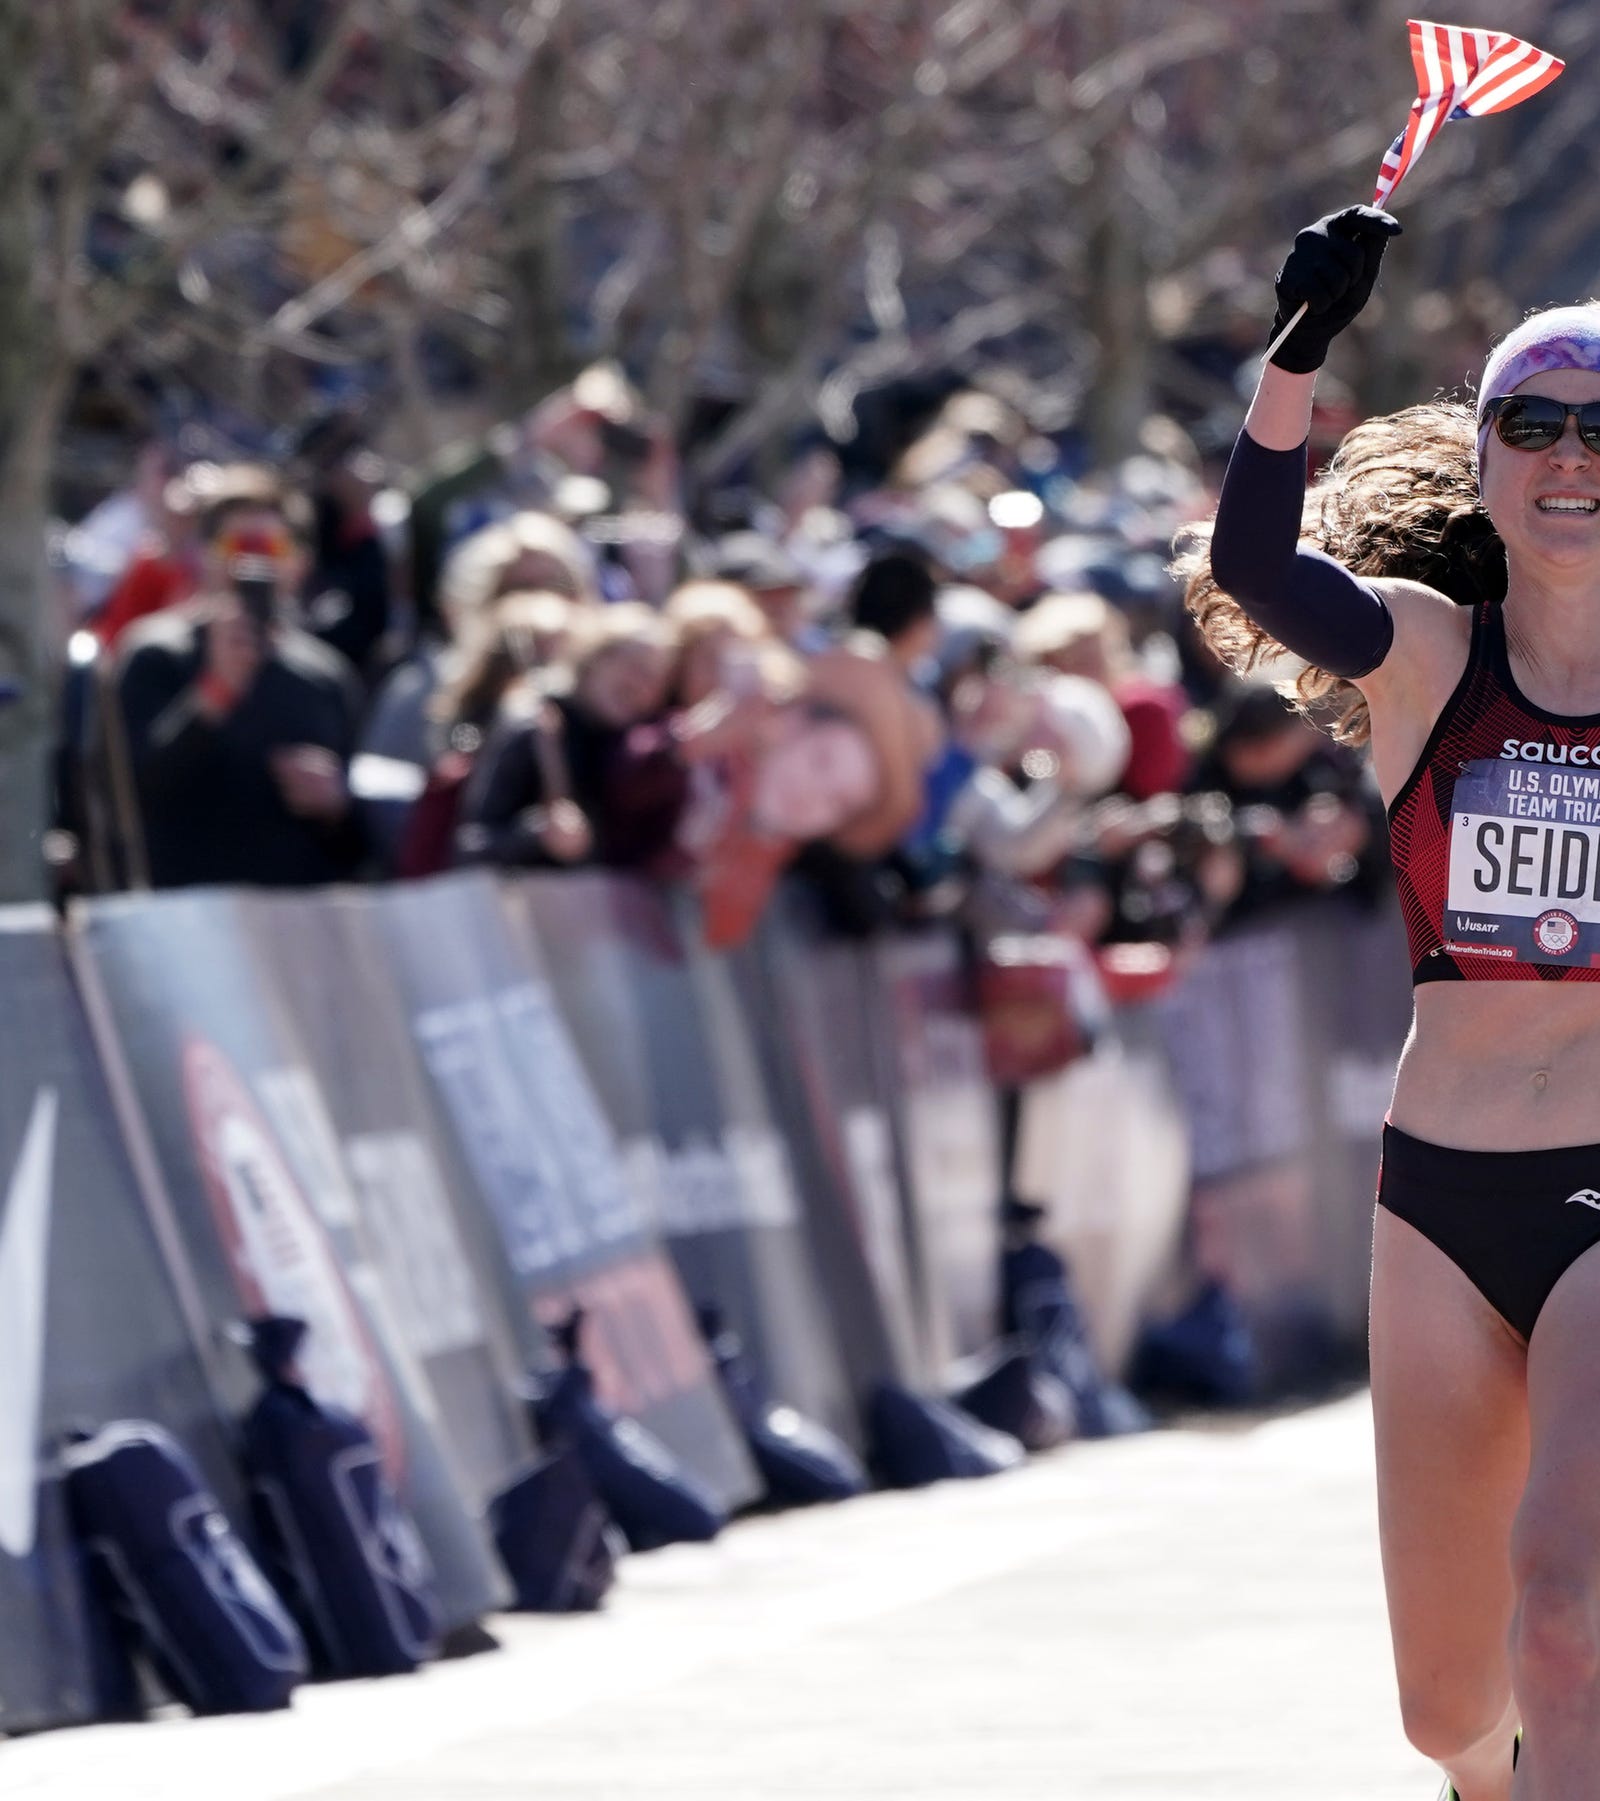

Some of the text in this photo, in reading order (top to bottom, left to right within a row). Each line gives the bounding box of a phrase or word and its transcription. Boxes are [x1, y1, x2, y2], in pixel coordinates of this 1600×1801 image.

[1508, 769, 1543, 793] U.S.
[1507, 793, 1557, 818] TEAM
[1462, 816, 1470, 827] 3
[1469, 922, 1500, 933] USATF
[1445, 944, 1513, 957] #MarathonTrials20
